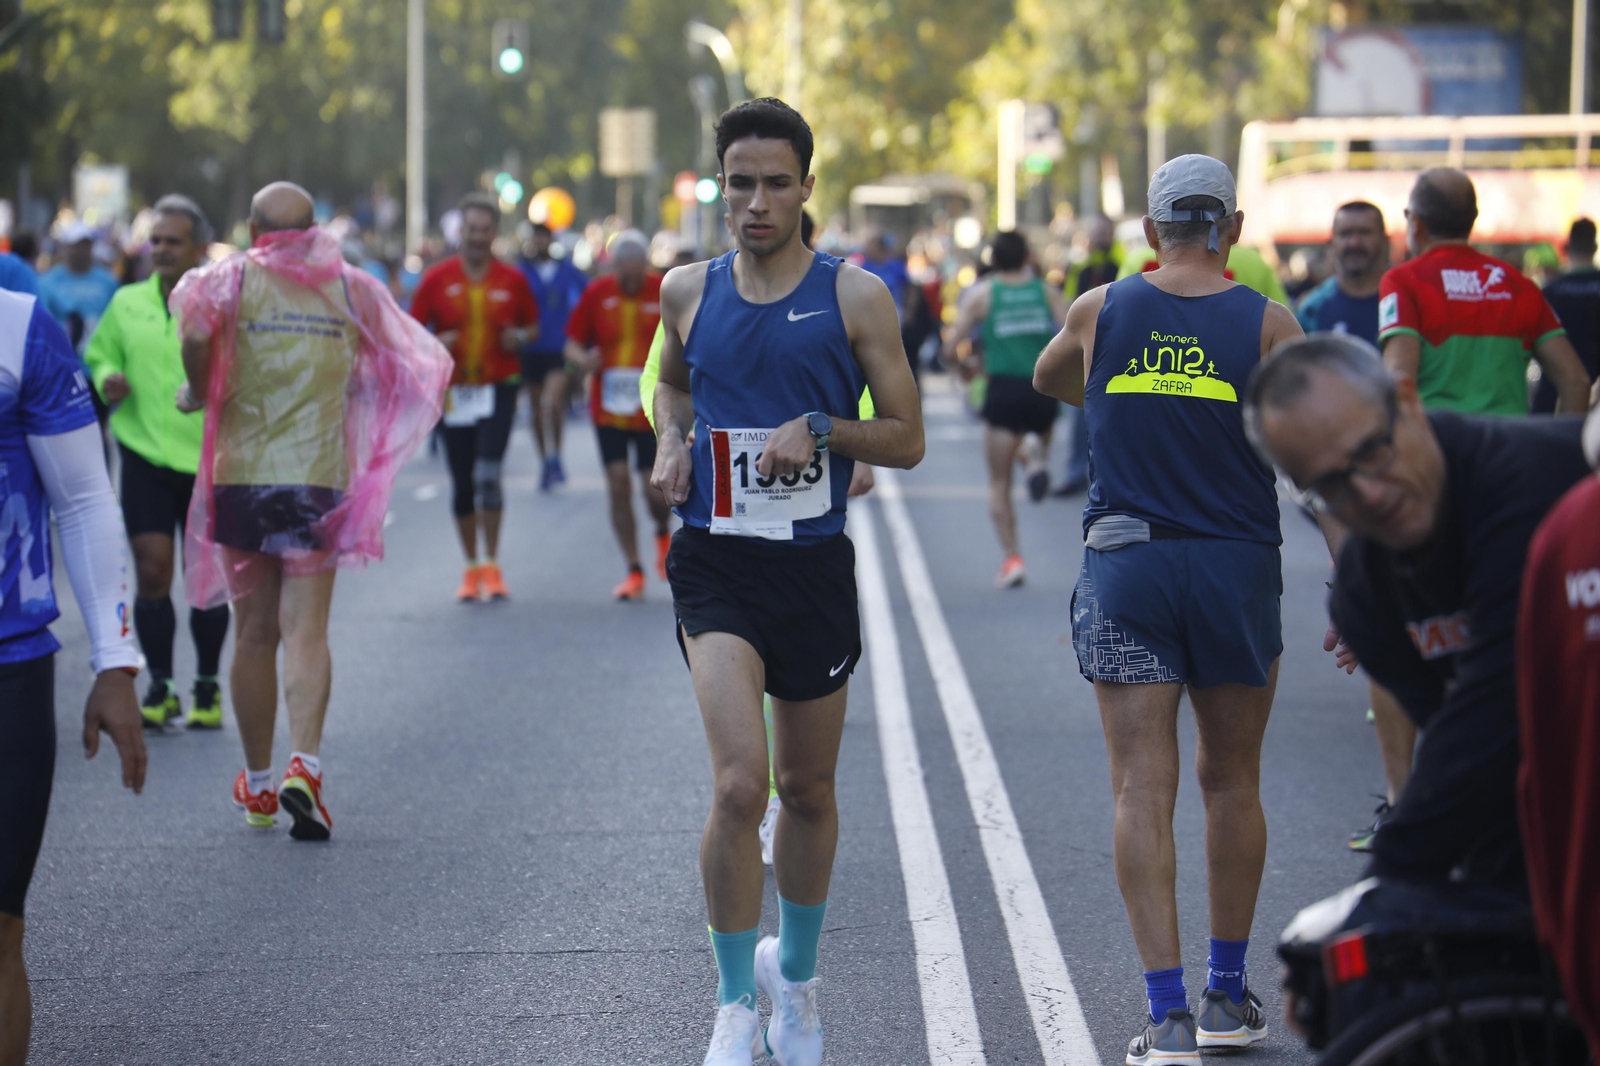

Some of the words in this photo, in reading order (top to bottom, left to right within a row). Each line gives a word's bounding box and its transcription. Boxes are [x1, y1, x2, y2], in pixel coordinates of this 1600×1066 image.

[1151, 331, 1198, 345] Runners
[1152, 379, 1192, 393] ZAFRA
[743, 432, 770, 442] IMD
